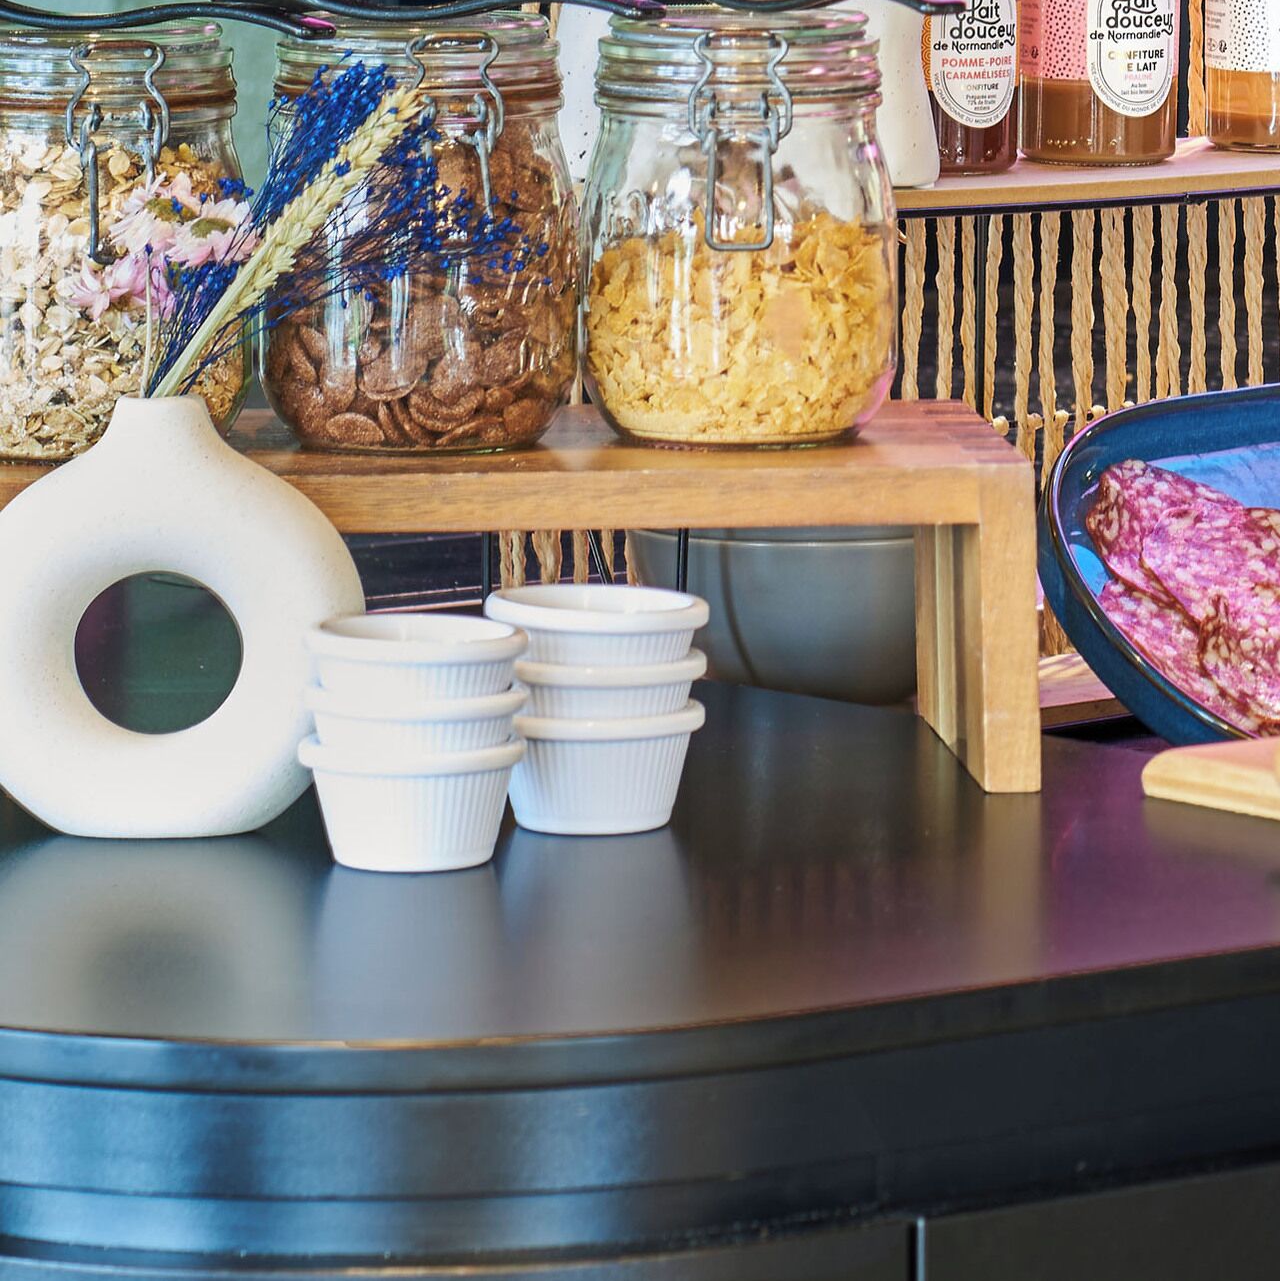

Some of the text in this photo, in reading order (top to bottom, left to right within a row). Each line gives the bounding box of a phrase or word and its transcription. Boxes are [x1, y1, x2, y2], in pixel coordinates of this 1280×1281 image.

[1106, 7, 1173, 35] douceur
[950, 17, 1015, 46] douceur
[1090, 29, 1161, 43] de Normandie
[933, 40, 1004, 54] de Normandie
[941, 55, 1012, 67] POMME-POIRE
[1108, 49, 1164, 60] CNFITURE
[1137, 62, 1157, 71] LAIT
[963, 83, 999, 91] ONFITURE
